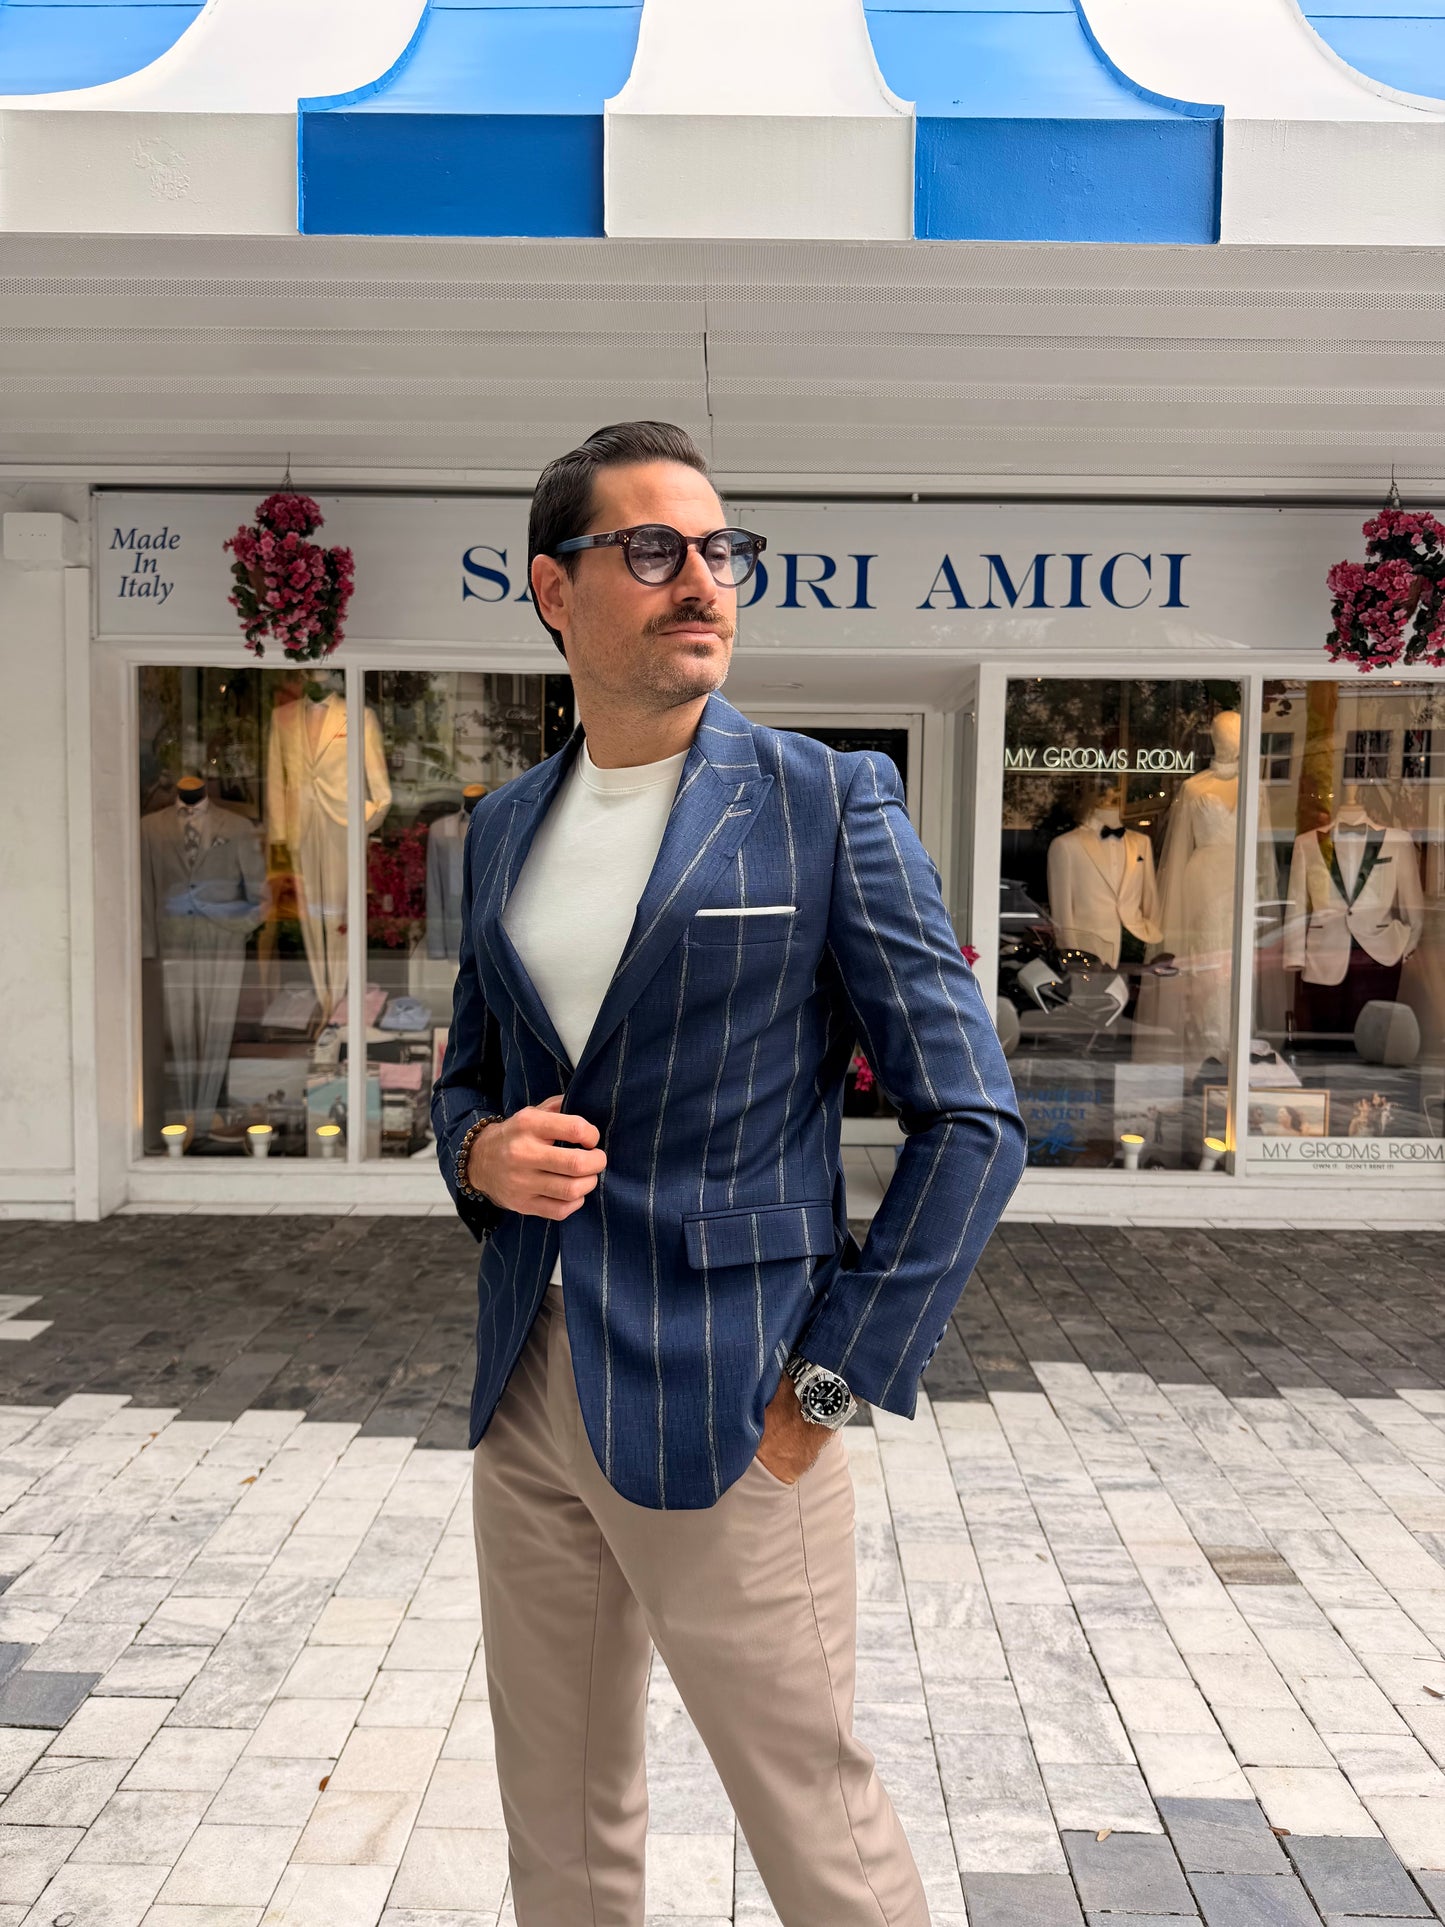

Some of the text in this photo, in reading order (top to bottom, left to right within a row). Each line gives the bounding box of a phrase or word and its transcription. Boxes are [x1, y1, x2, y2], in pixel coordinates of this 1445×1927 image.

[109, 527, 181, 550] Made
[132, 552, 157, 574] In
[462, 545, 1192, 610] SORI AMICI
[118, 575, 174, 605] Italy
[1004, 746, 1195, 771] MY GROOMS ROOM
[1262, 1141, 1444, 1161] MY GROOMS ROOM
